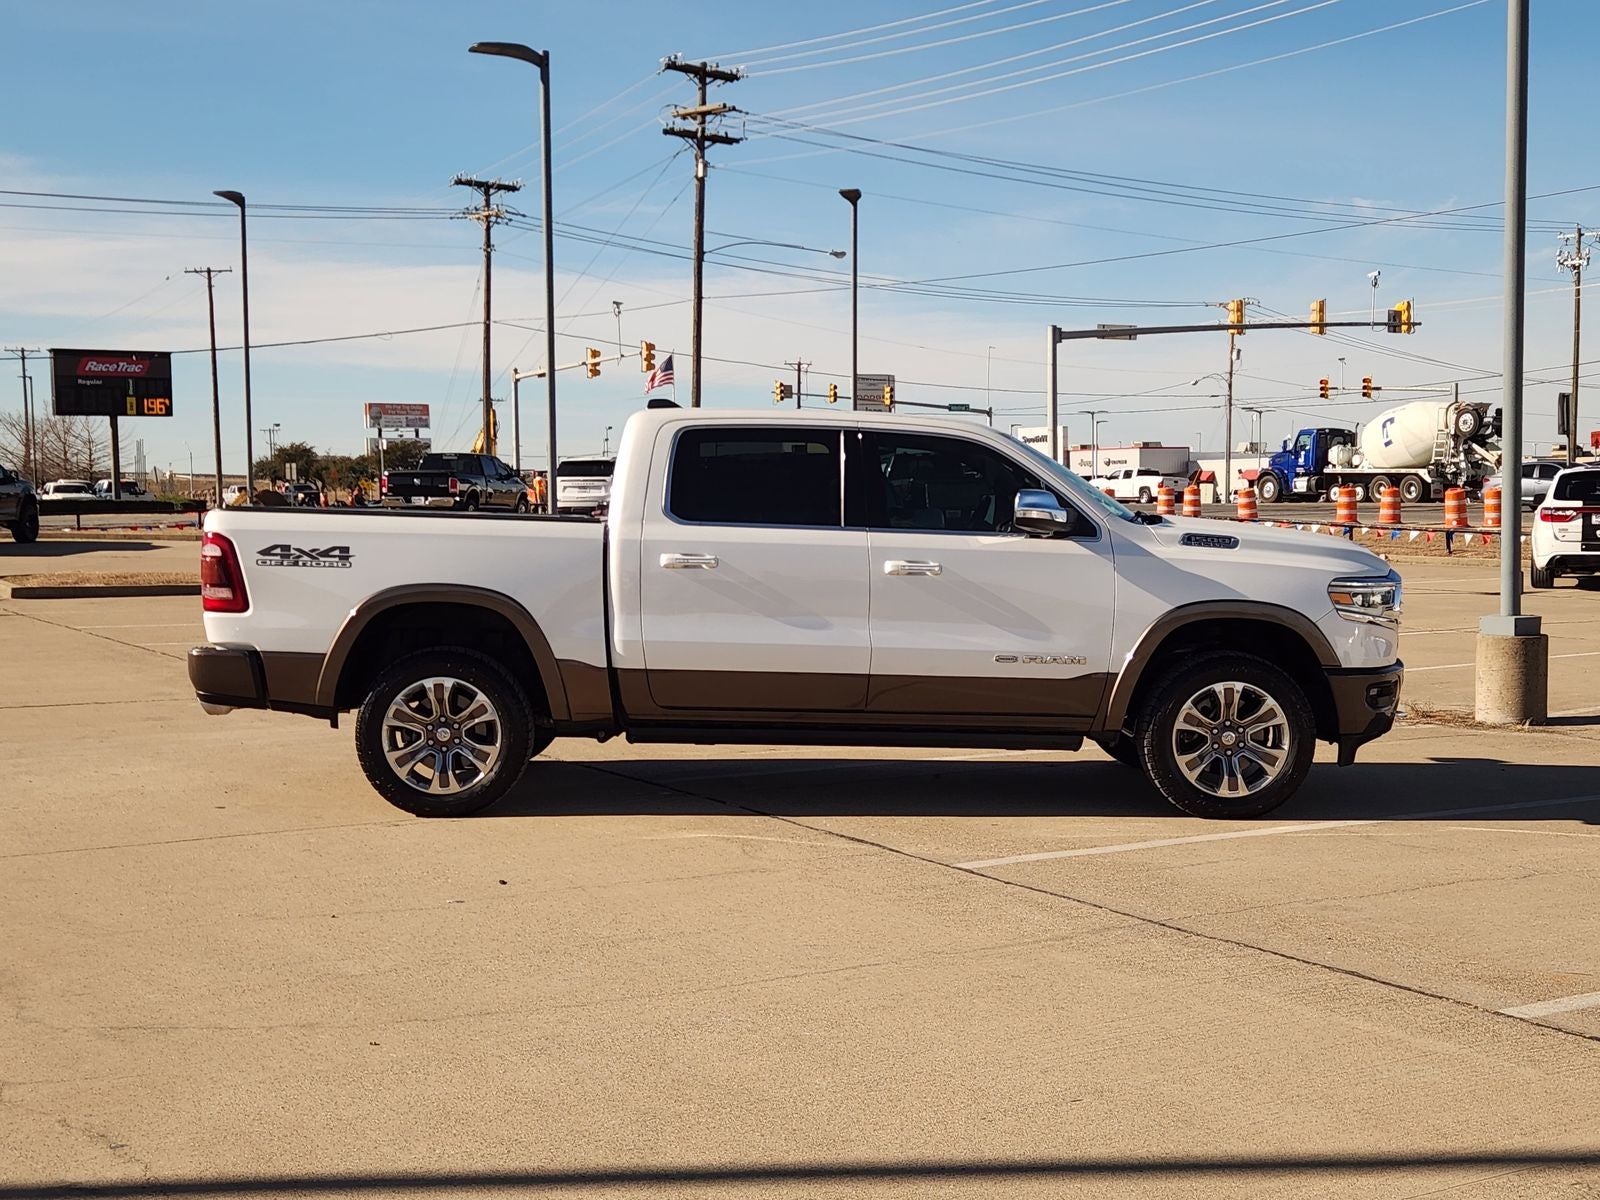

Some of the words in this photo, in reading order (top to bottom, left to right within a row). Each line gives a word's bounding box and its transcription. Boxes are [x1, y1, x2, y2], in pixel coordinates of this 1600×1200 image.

[85, 361, 143, 372] RaceTrac
[256, 544, 356, 562] 4x4
[1022, 655, 1087, 665] RAM
